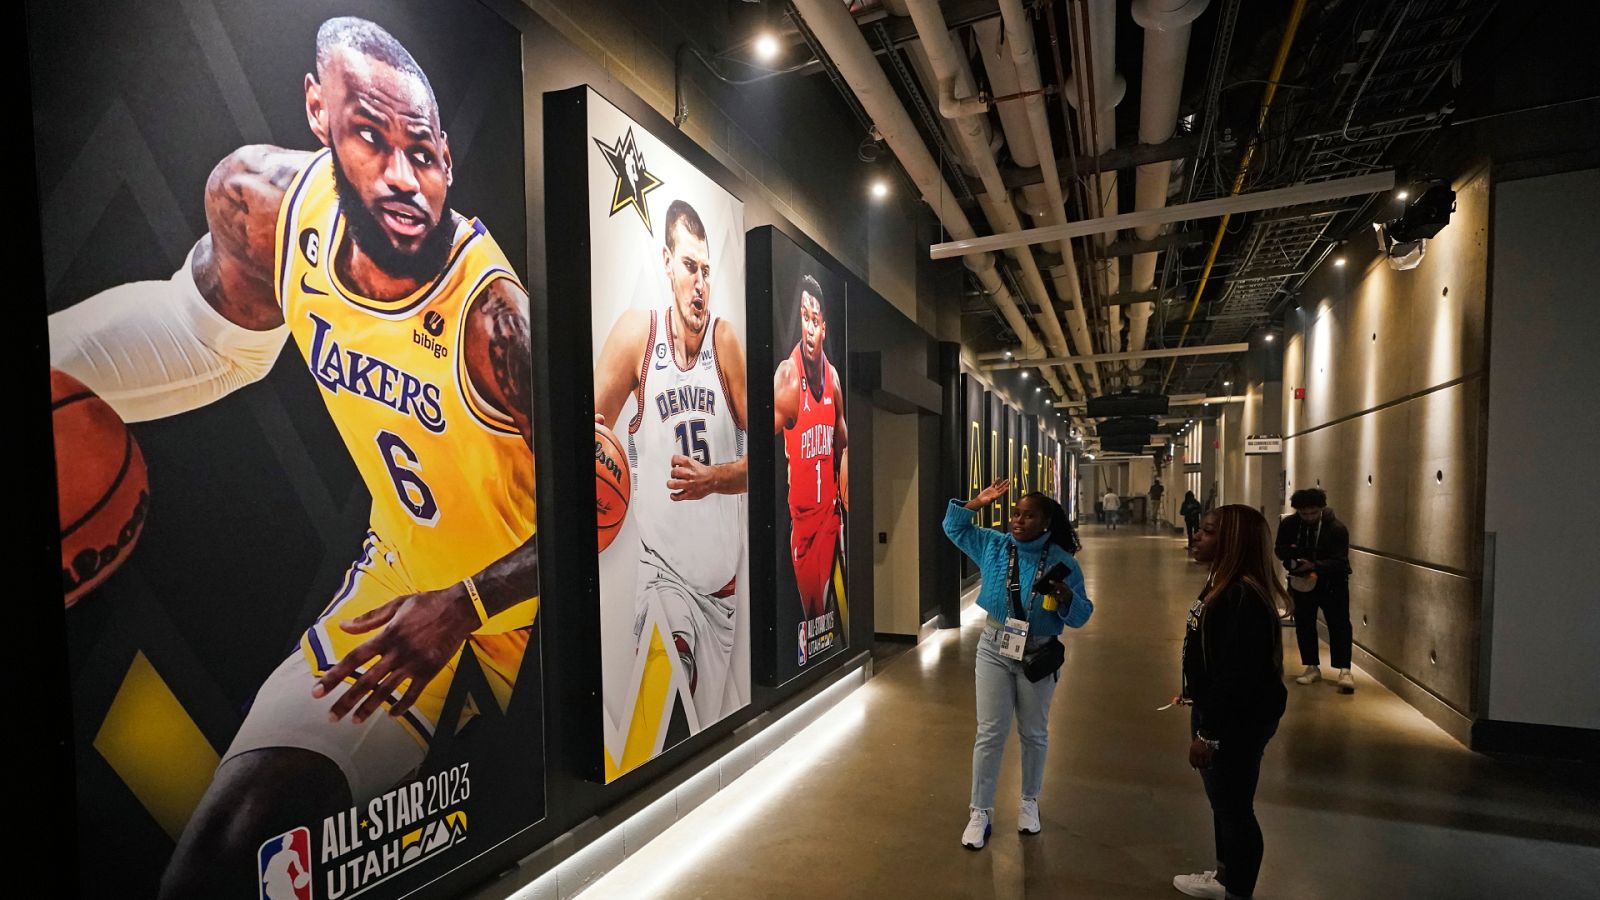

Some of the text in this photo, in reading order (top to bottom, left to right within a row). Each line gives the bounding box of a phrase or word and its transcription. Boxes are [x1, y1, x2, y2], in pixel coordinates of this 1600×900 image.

[305, 231, 320, 265] 6
[412, 329, 448, 359] bibigo
[307, 311, 447, 434] LAKERS
[655, 385, 716, 423] DENVER
[674, 419, 712, 467] 15
[374, 428, 442, 529] 6
[815, 460, 822, 504] 1
[321, 762, 470, 864] ALL STAR 2023
[327, 839, 399, 900] UTAH
